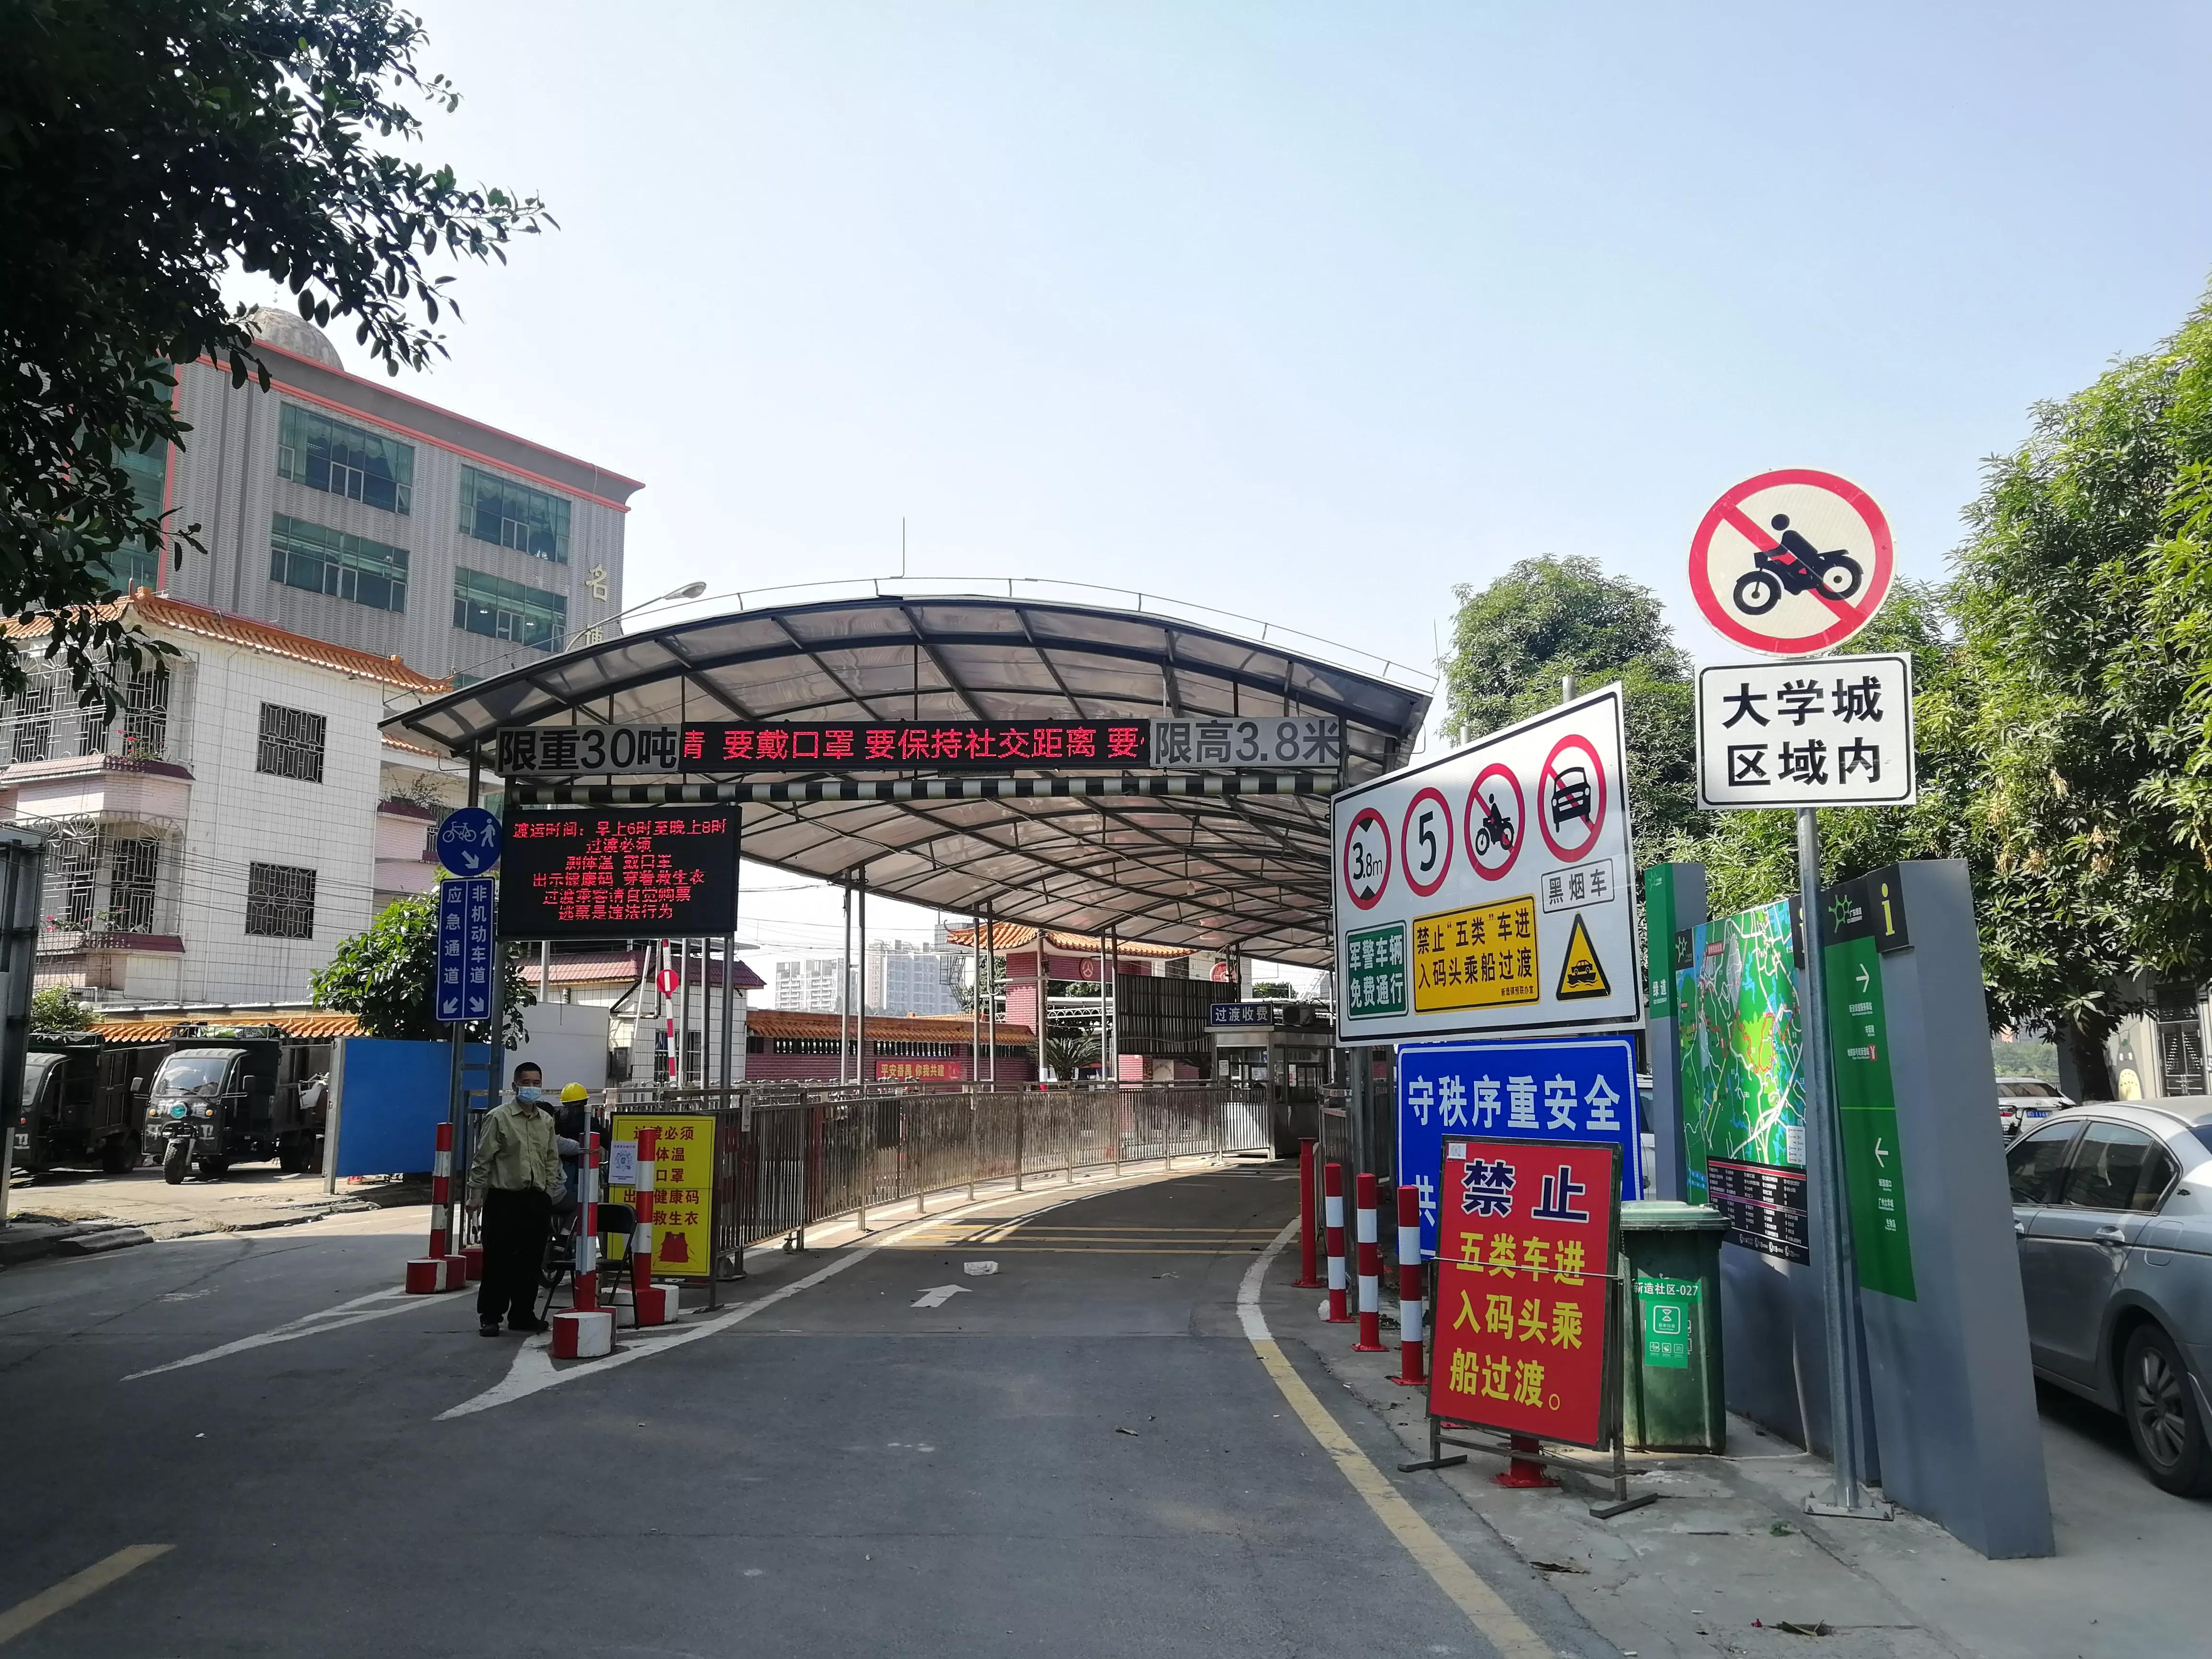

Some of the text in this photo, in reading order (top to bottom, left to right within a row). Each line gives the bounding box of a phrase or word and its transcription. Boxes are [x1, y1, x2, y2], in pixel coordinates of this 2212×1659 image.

[1722, 675, 1884, 729] 大学城
[497, 726, 678, 772] 限重30吨
[723, 729, 854, 760] 要戴口罩
[865, 726, 1095, 760] 要保持社交距离
[1155, 721, 1339, 764] 限高3.8米
[1728, 737, 1881, 787] 区域内
[586, 837, 652, 853] 过渡必须
[1419, 811, 1437, 872] 5
[533, 871, 614, 887] 出示健康码
[565, 855, 614, 870] 测体温
[1352, 842, 1382, 880] 3.8m
[543, 886, 691, 905] 过渡乘客请自觉购票
[1549, 867, 1608, 905] 黑烟车
[558, 903, 673, 920] 逃票是违法行为
[444, 886, 462, 985] 应急通道
[470, 885, 487, 984] 非机动车道
[1349, 934, 1403, 972] 军警车辆
[1418, 946, 1533, 990] 入码头乘船过渡
[1350, 973, 1403, 1009] 免费通行
[1215, 1006, 1268, 1022] 过渡收费
[881, 1063, 945, 1077] 平安番禺 你我共建
[1408, 1072, 1620, 1131] 守秩序重安全
[624, 1189, 699, 1205] 出健康码
[1462, 1157, 1589, 1224] 禁止
[1456, 1231, 1585, 1286] 五类车进
[1633, 1282, 1698, 1296] 新造社区-027
[1453, 1289, 1583, 1350] 入码头乘
[1449, 1347, 1561, 1411] 船过渡。
